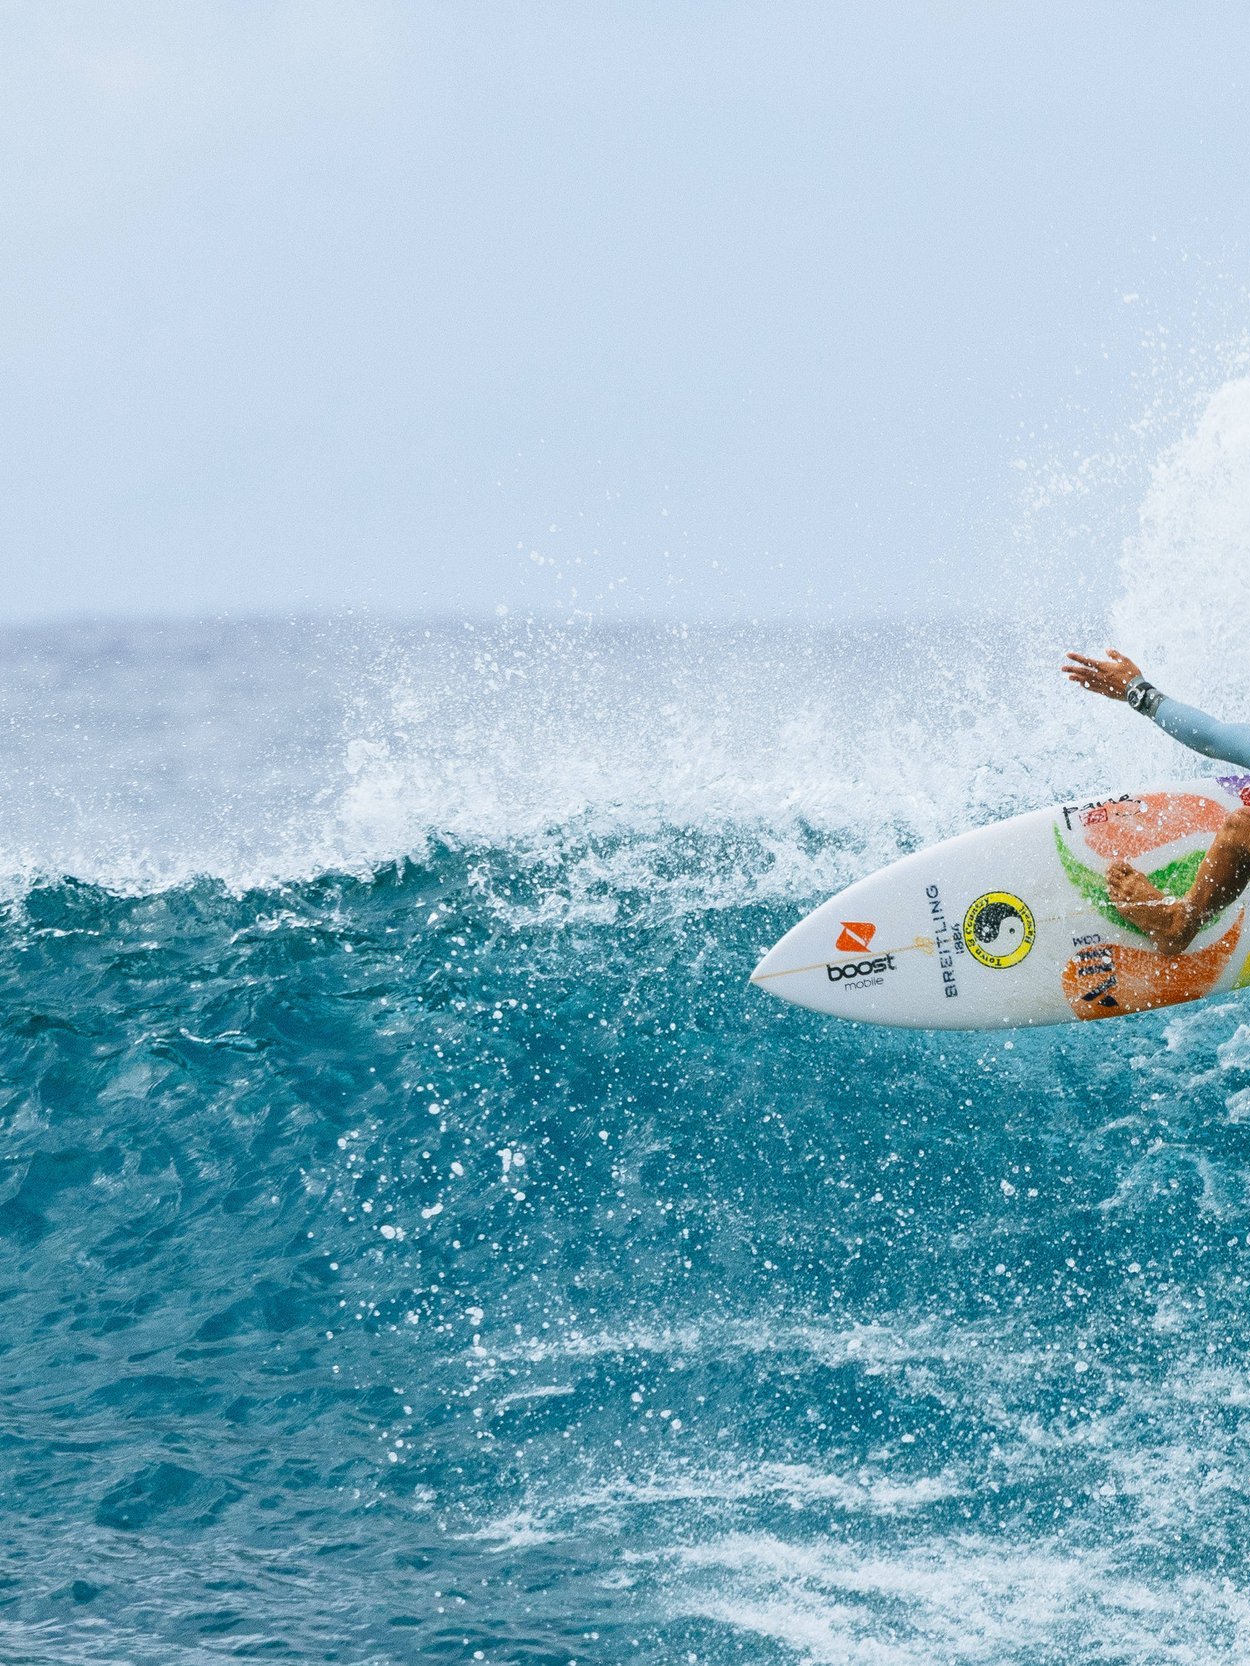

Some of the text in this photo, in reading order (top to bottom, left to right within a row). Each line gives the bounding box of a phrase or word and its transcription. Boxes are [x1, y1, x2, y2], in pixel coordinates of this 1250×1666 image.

[926, 885, 958, 998] BREITLING
[951, 923, 965, 955] 1884
[826, 952, 896, 982] boost
[976, 948, 1002, 967] Town
[844, 977, 885, 991] mobile
